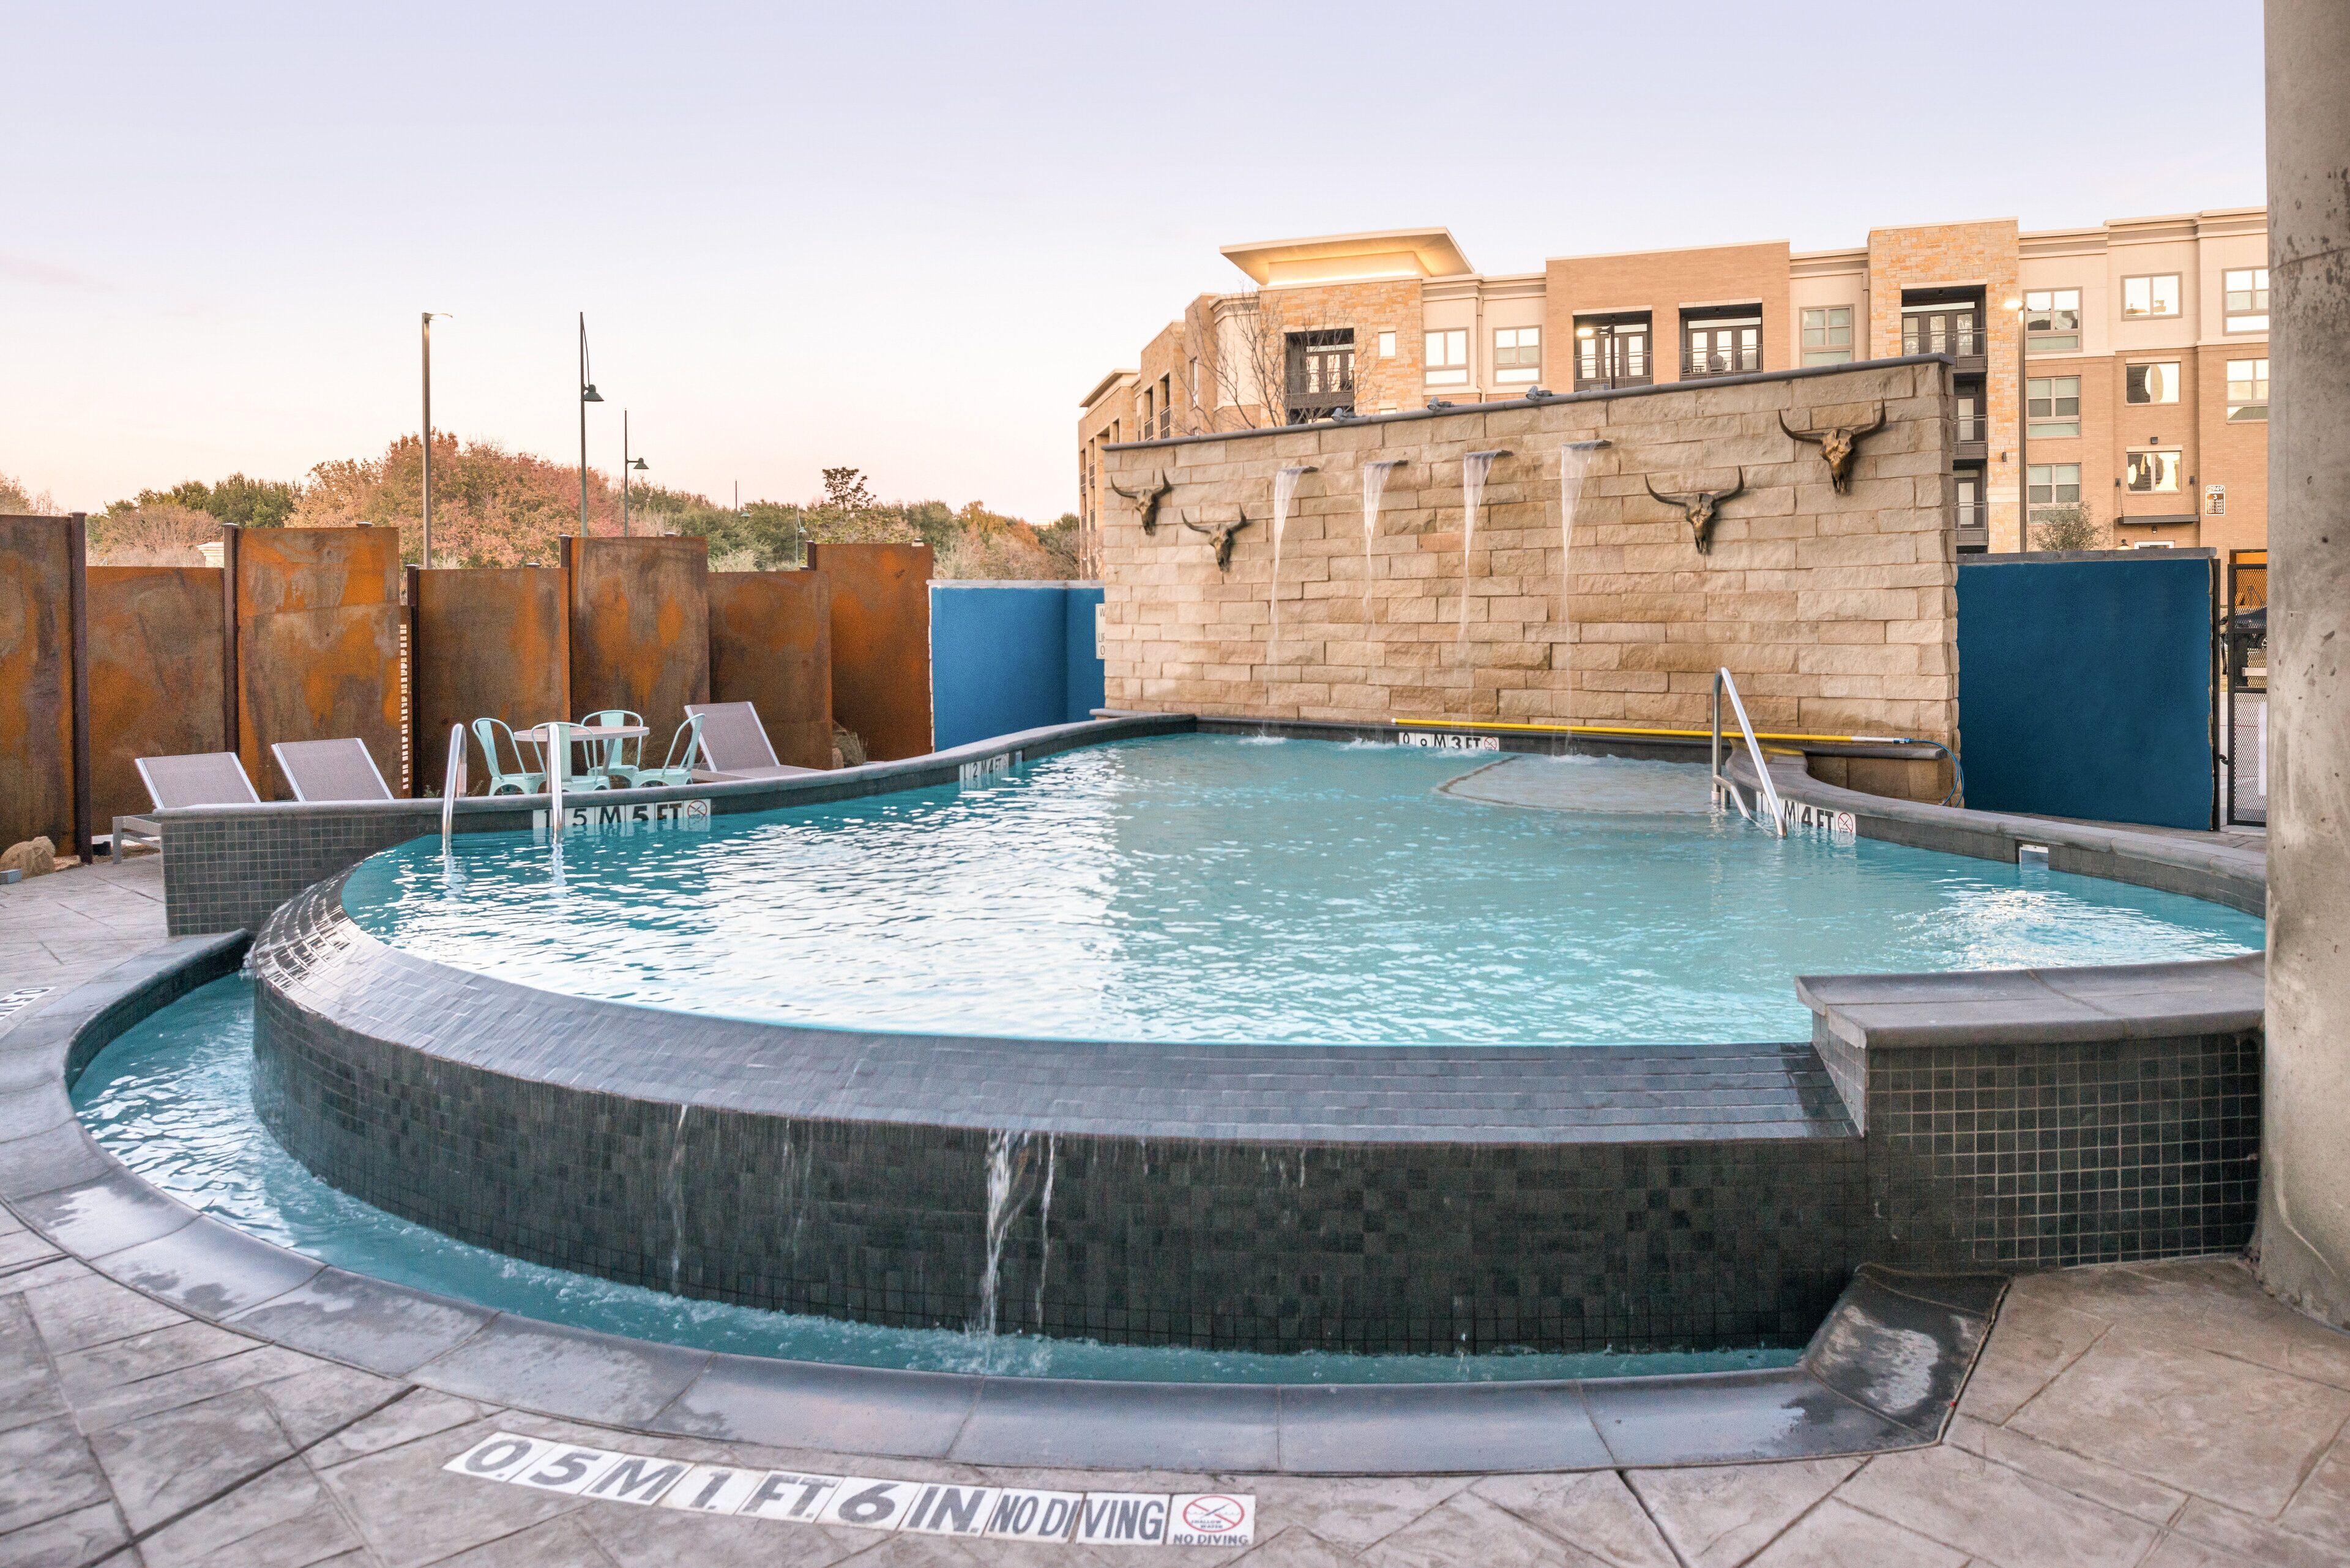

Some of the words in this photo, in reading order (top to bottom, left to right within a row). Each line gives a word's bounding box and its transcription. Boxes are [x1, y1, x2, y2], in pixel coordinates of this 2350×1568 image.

[657, 803, 682, 820] FT
[1817, 809, 1833, 831] FT
[989, 1495, 1039, 1534] NO
[1174, 1534, 1193, 1544] NO
[1197, 1534, 1248, 1544] DIVING
